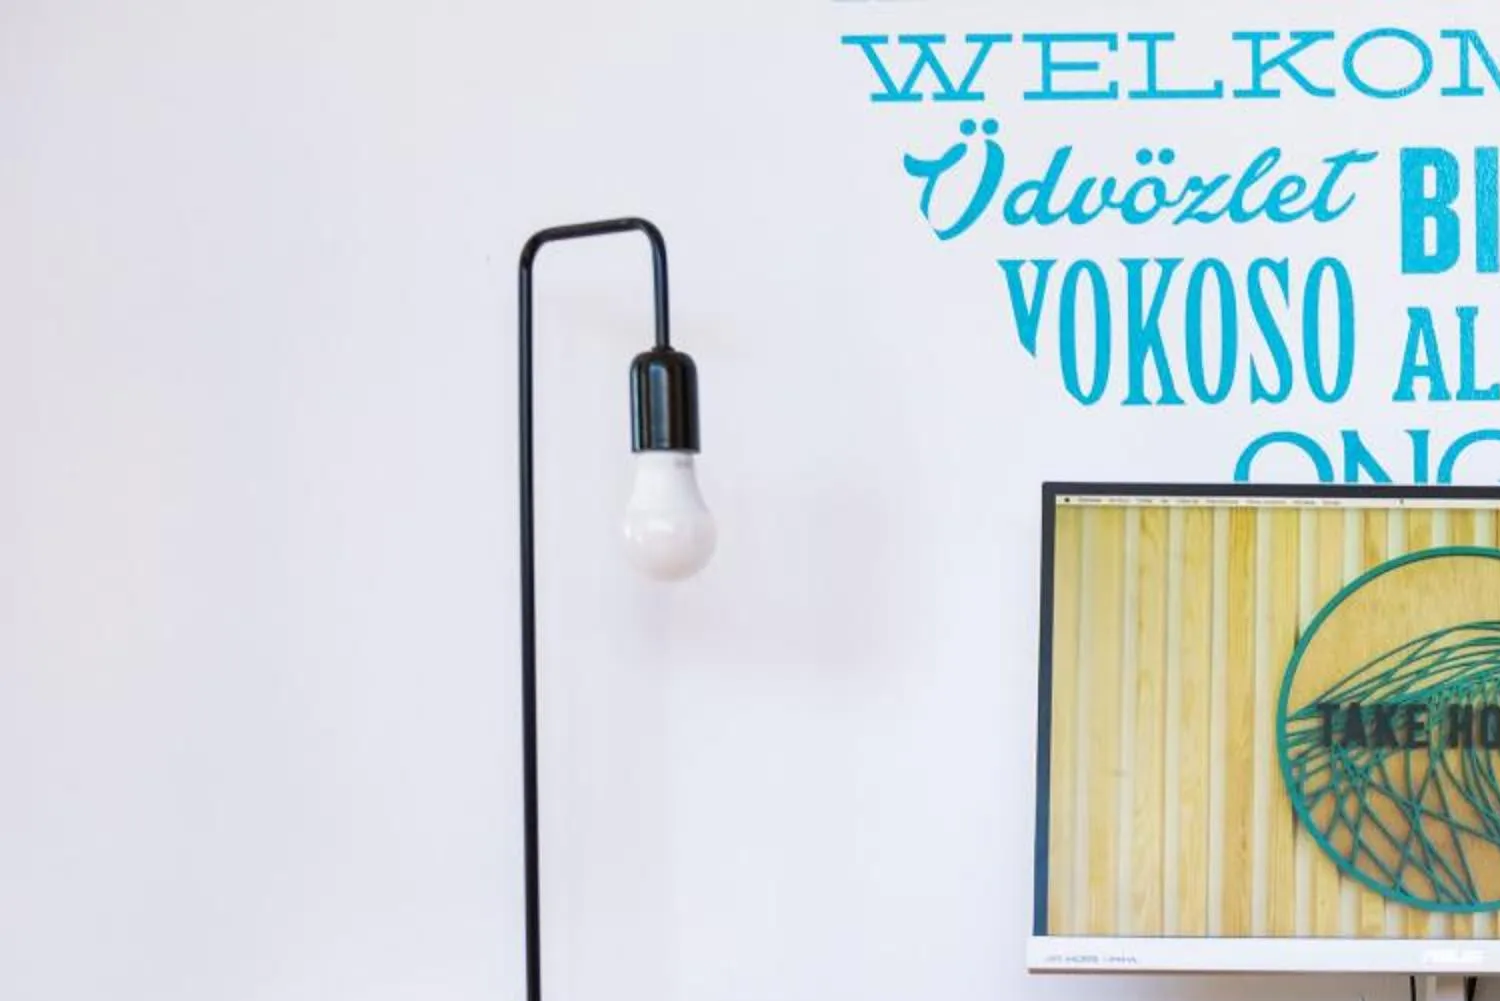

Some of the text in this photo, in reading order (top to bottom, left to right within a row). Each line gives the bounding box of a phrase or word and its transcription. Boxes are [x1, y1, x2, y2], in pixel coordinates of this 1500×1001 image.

[902, 118, 1380, 242] Üdvözlet
[997, 256, 1357, 407] VOKOSO
[1316, 702, 1429, 749] TAKE
